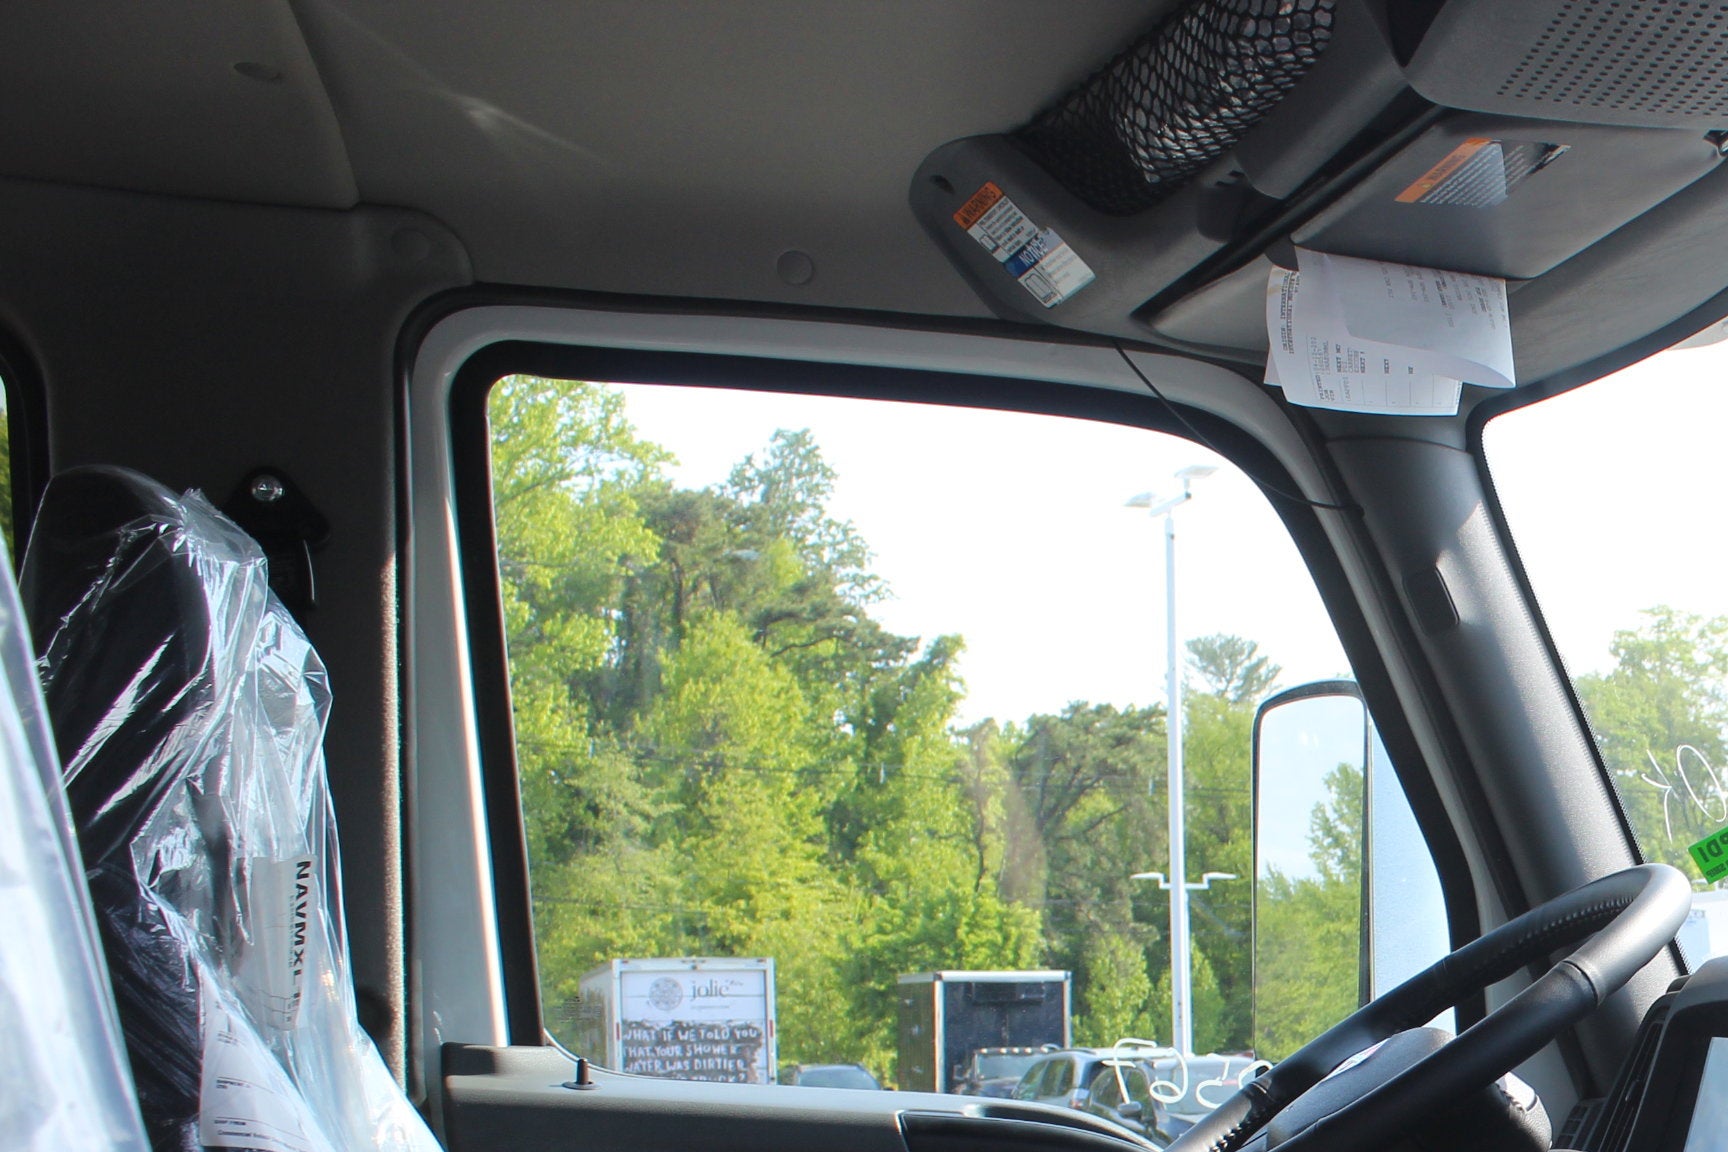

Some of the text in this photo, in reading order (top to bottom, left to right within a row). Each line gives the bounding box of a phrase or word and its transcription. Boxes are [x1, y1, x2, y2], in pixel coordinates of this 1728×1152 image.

[1018, 236, 1049, 268] NOTICE
[662, 1029, 674, 1042] IF
[677, 1028, 697, 1042] WE
[734, 1028, 758, 1041] YOU
[665, 1058, 690, 1071] WAS
[694, 1057, 747, 1071] DIRTIER
